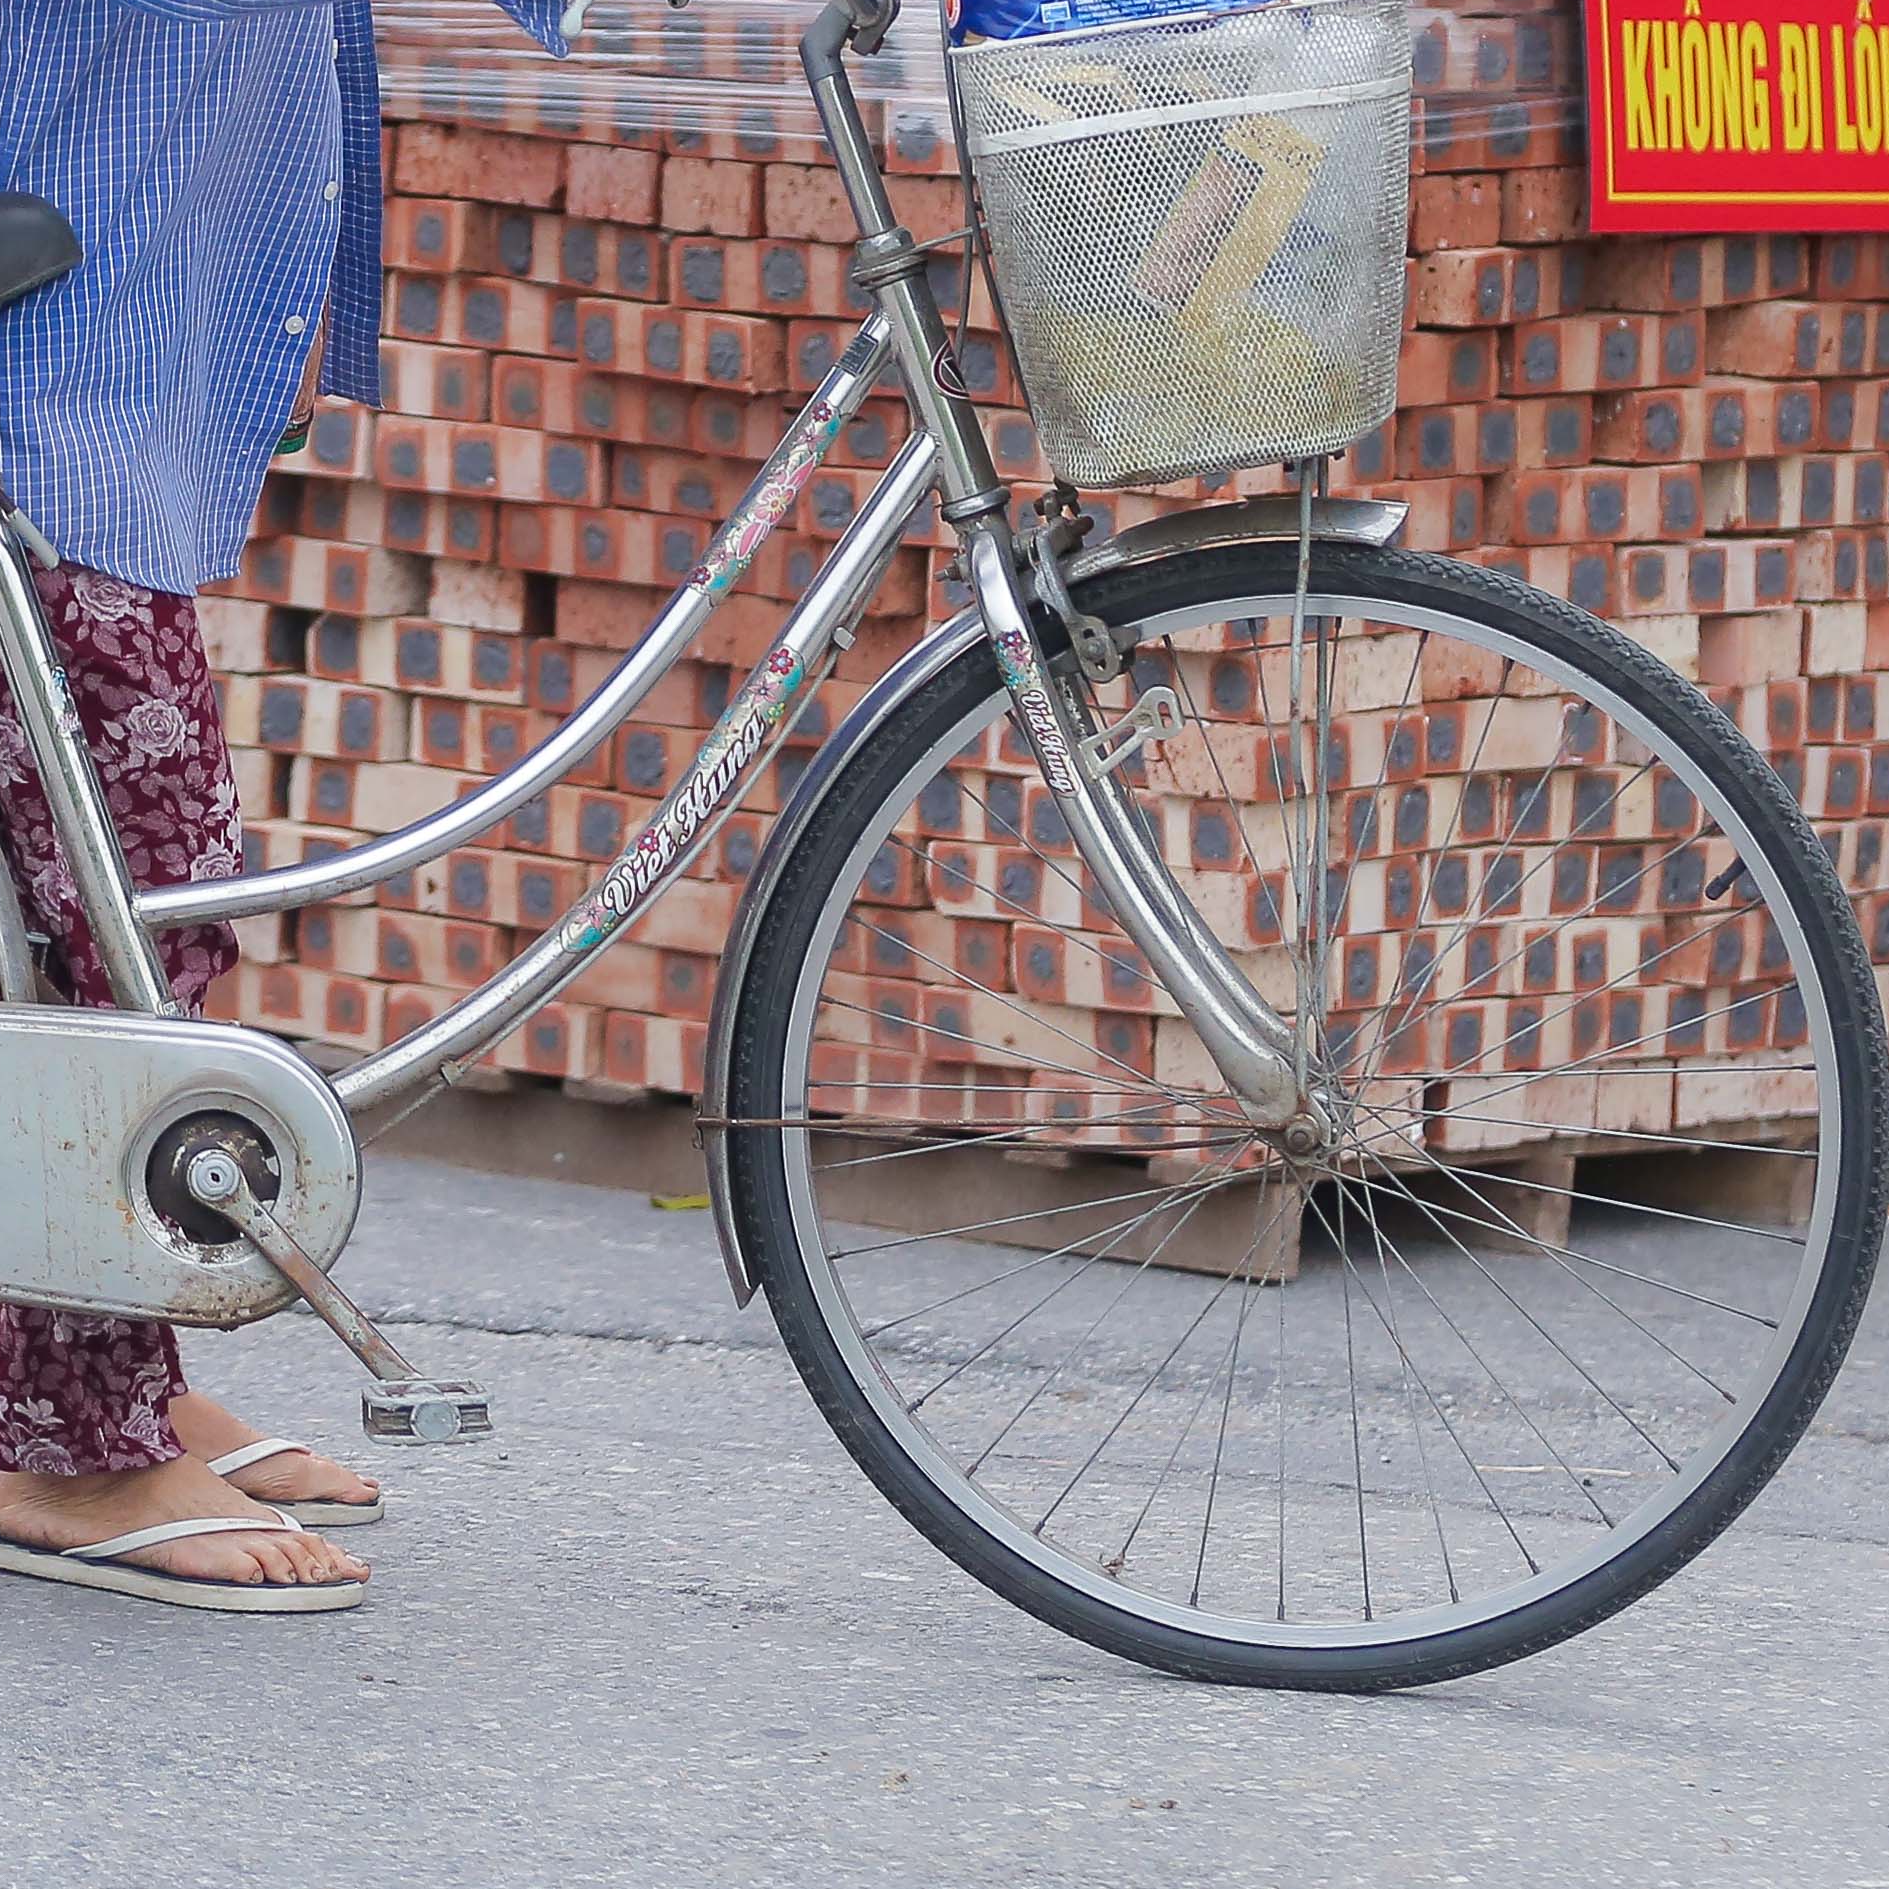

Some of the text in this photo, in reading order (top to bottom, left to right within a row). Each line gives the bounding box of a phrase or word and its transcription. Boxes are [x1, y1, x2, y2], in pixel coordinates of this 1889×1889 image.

[1779, 22, 1824, 152] ĐI
[602, 709, 767, 916] Viet Hung
